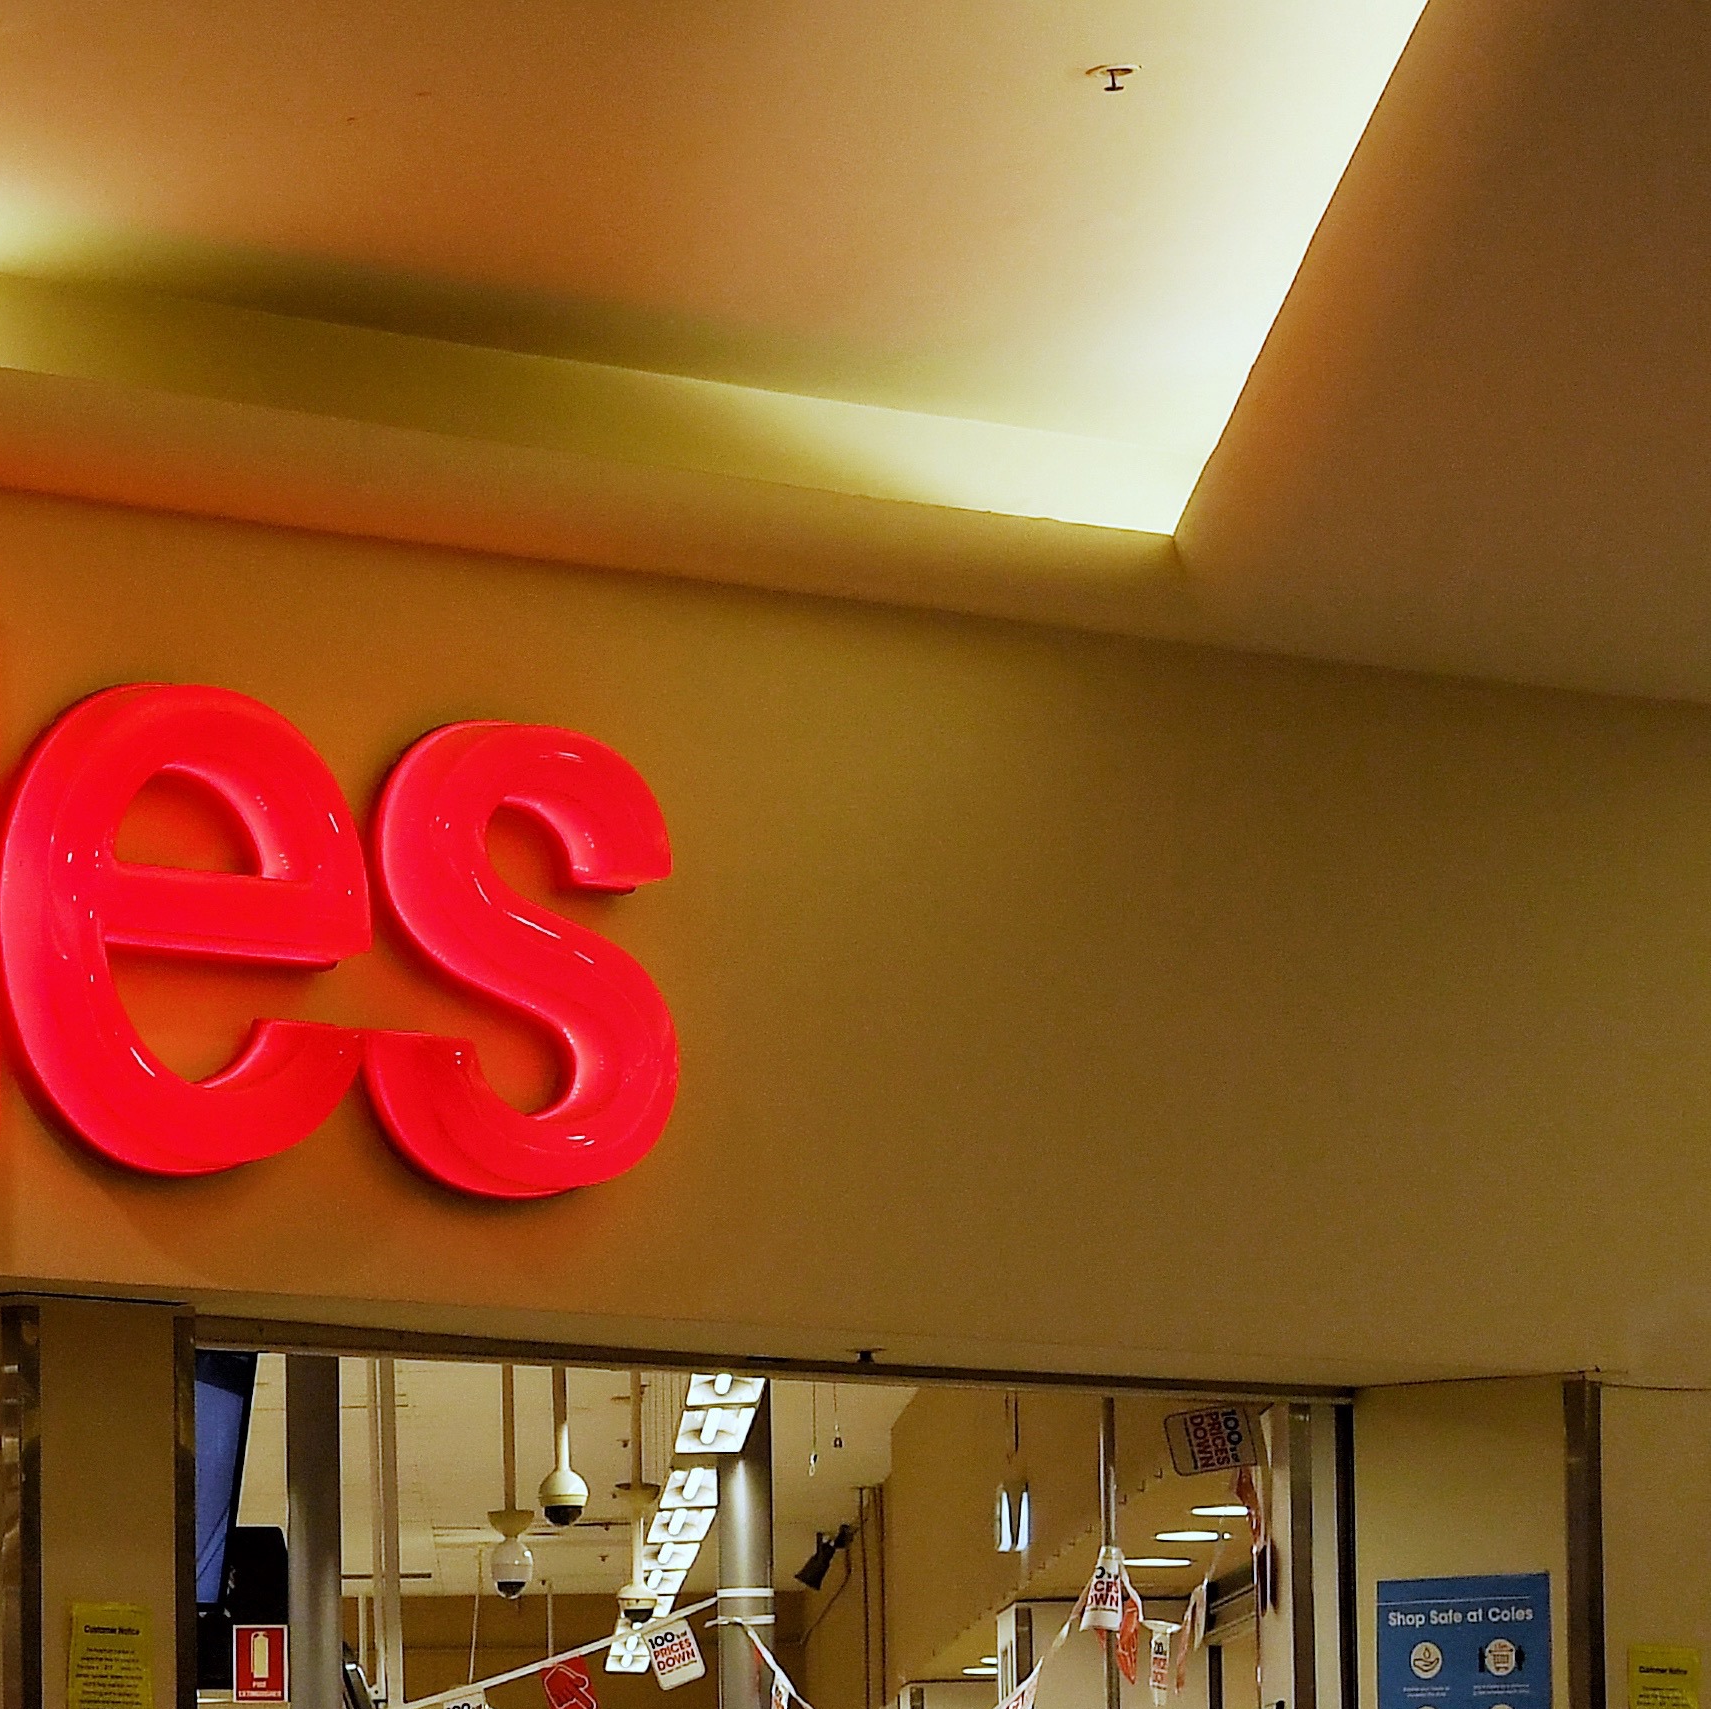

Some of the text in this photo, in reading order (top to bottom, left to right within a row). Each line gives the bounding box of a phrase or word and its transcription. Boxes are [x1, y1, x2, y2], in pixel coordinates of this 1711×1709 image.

[1387, 1610, 1425, 1628] Shop
[1429, 1609, 1462, 1625] Safe
[1487, 1607, 1534, 1622] Coles
